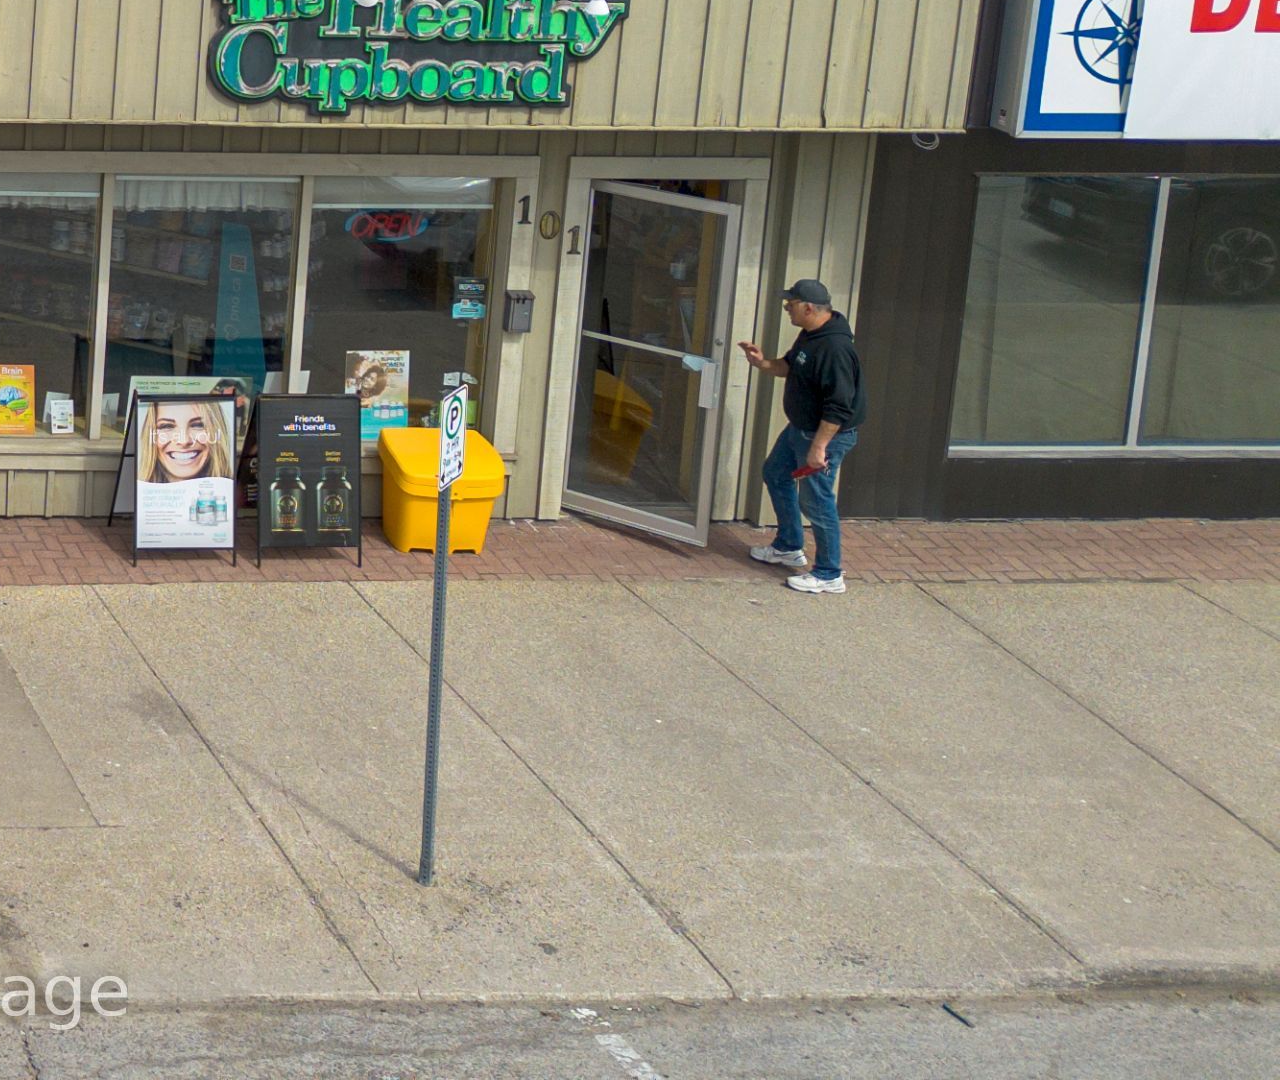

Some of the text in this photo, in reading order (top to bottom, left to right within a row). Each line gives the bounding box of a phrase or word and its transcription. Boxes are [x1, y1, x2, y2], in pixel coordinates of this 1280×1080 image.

[216, 22, 567, 112] Cupboard
[351, 212, 422, 238] OPEN
[1, 366, 23, 375] Brain
[283, 423, 336, 431] with benefits
[294, 415, 324, 423] Friends
[451, 405, 458, 430] P
[149, 428, 169, 445] It's
[190, 428, 221, 448] you!
